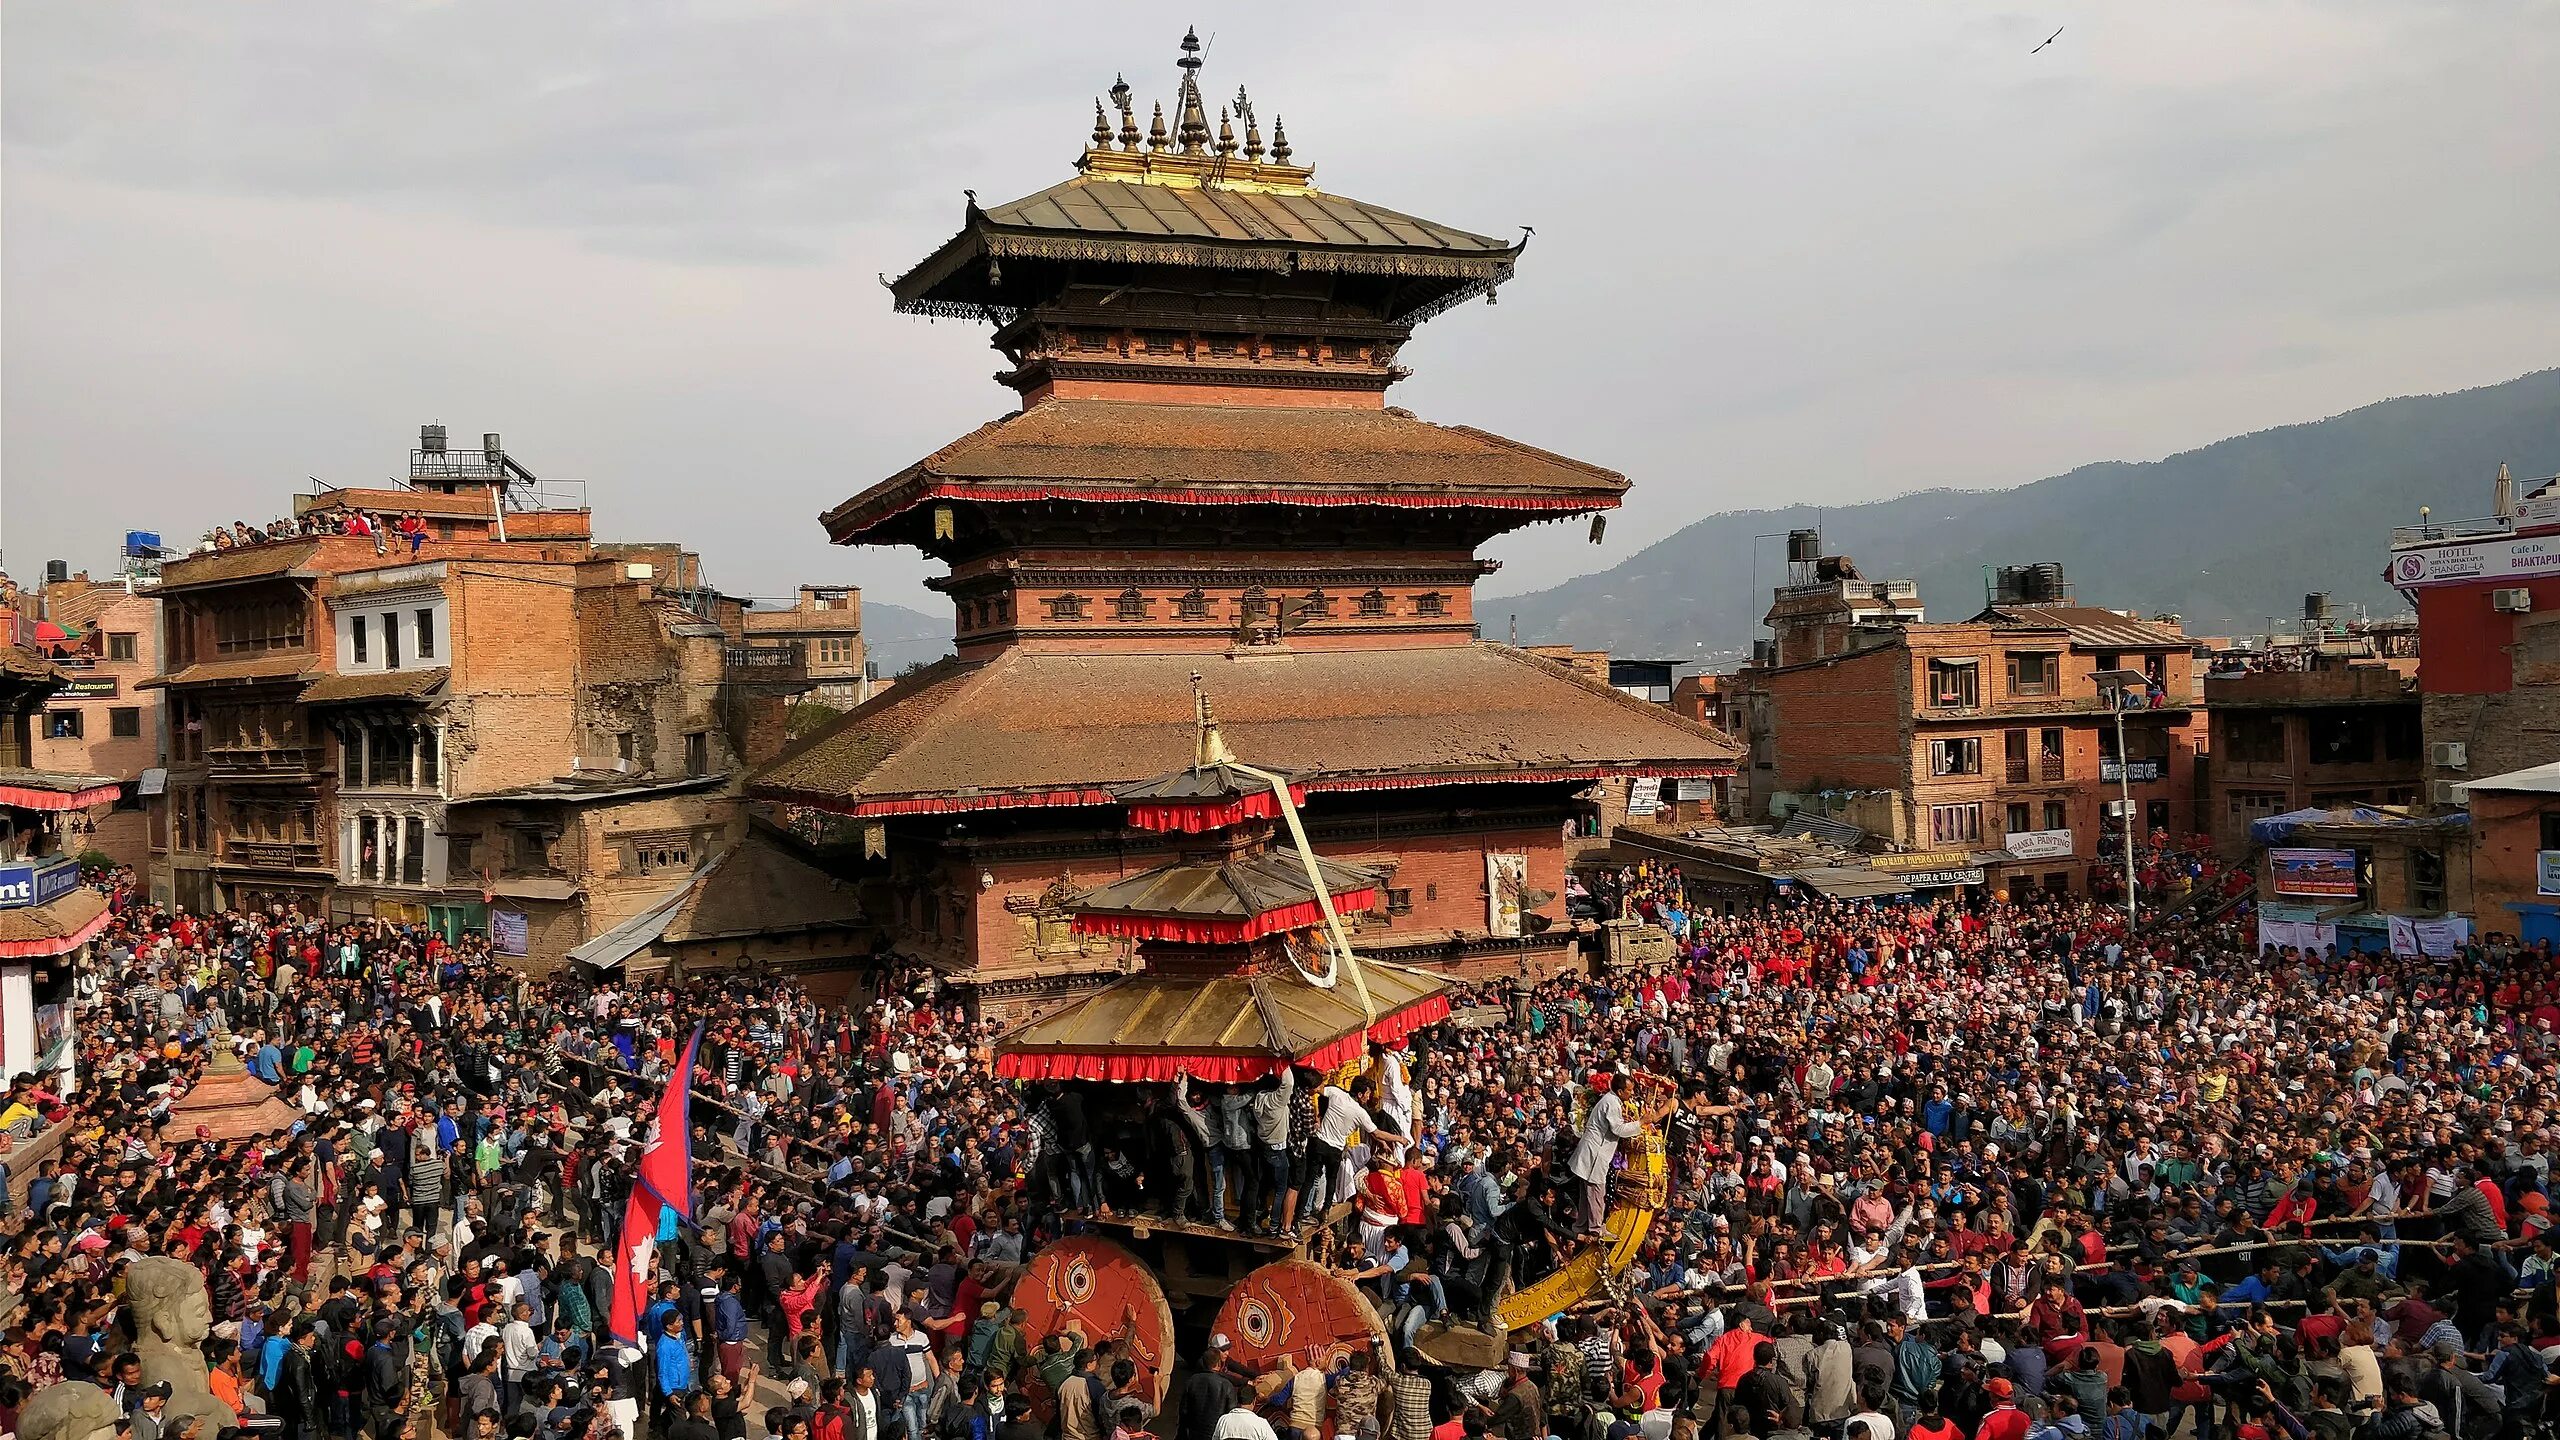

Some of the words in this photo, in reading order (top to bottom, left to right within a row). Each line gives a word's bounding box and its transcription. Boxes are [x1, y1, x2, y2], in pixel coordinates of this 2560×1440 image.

[2438, 547, 2474, 559] HOTEL
[2511, 545, 2530, 555] Cafe
[2511, 554, 2560, 568] BHAKTAPU
[2037, 836, 2071, 848] PAINTING
[1871, 858, 1888, 867] HAND
[1888, 857, 1905, 866] MADE
[1911, 873, 1931, 882] PAPER
[1932, 873, 1939, 881] &
[1939, 872, 1953, 880] TEA
[1953, 870, 1980, 880] CENTRE
